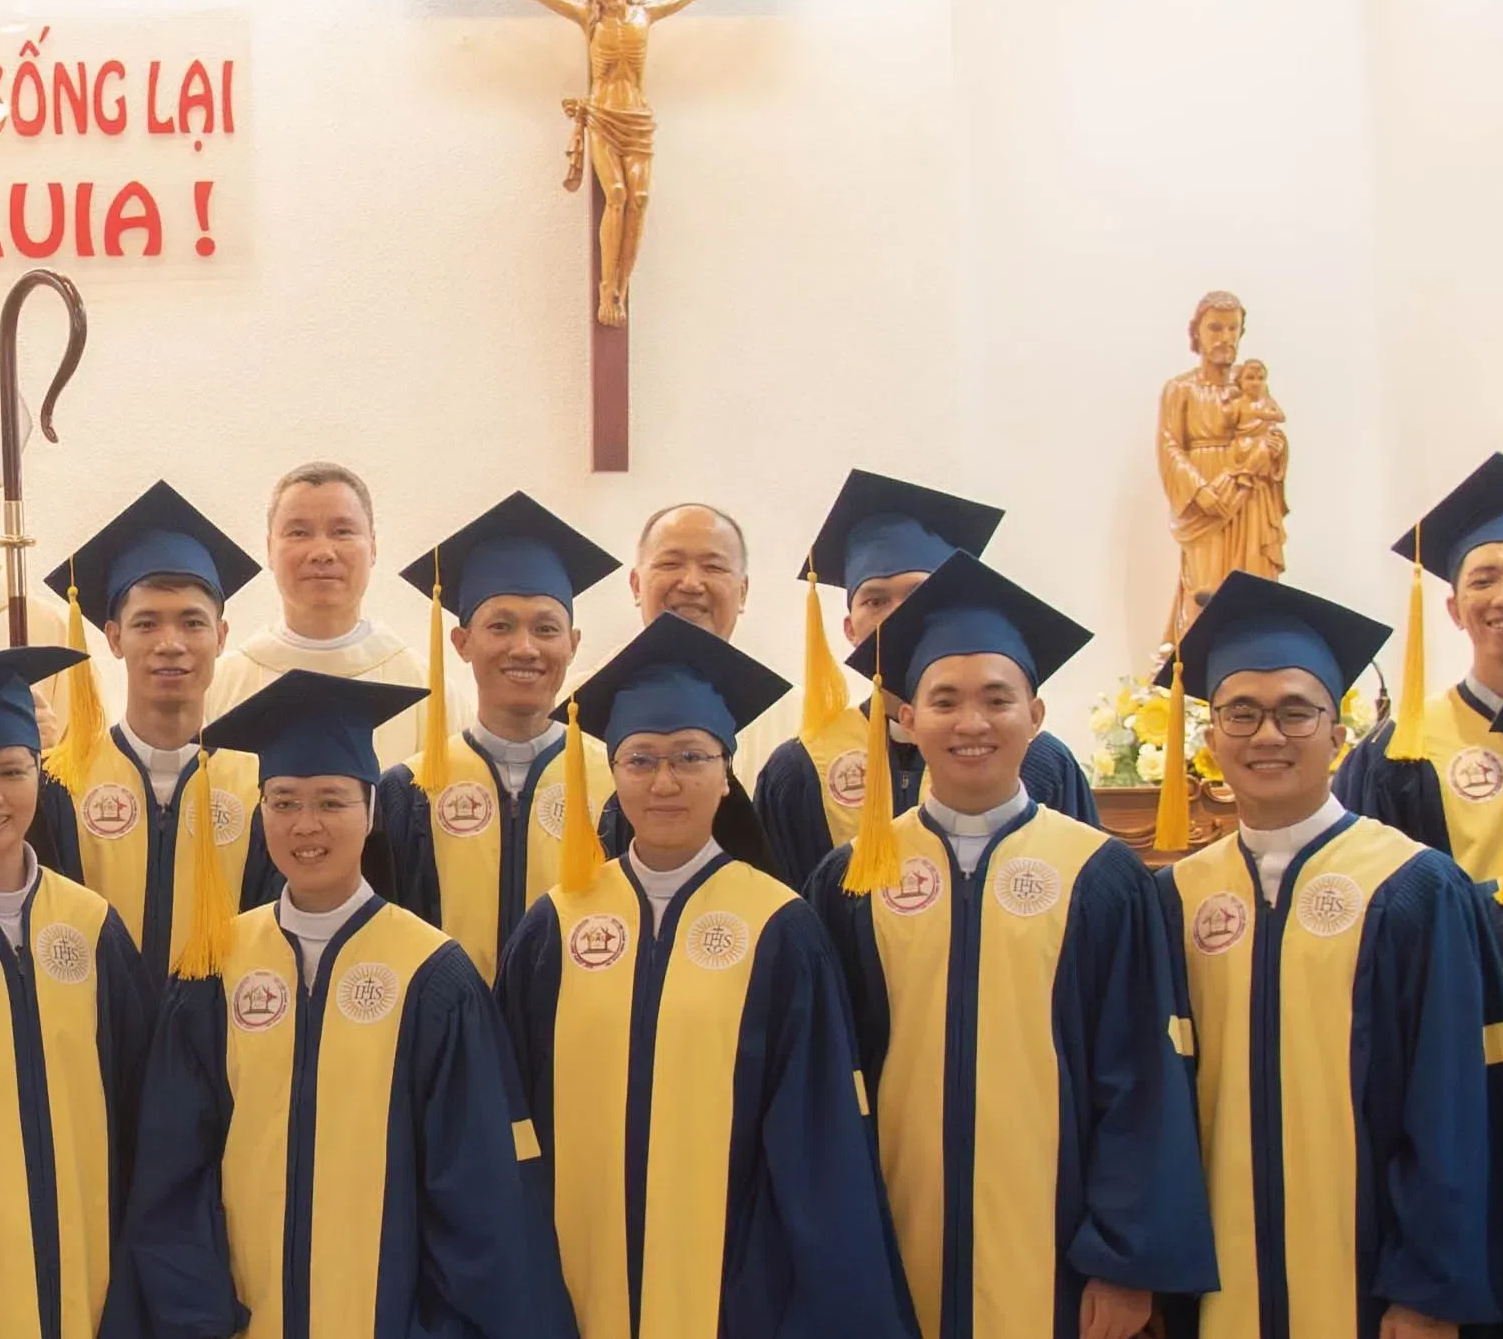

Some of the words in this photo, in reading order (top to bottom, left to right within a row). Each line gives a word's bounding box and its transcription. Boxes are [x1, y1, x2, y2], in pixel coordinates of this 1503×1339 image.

[146, 61, 235, 151] LẠI
[1013, 877, 1044, 893] IHS
[1314, 895, 1344, 912] IHS
[703, 933, 732, 949] IHS
[53, 945, 79, 961] IHS
[354, 985, 383, 1000] IHS
